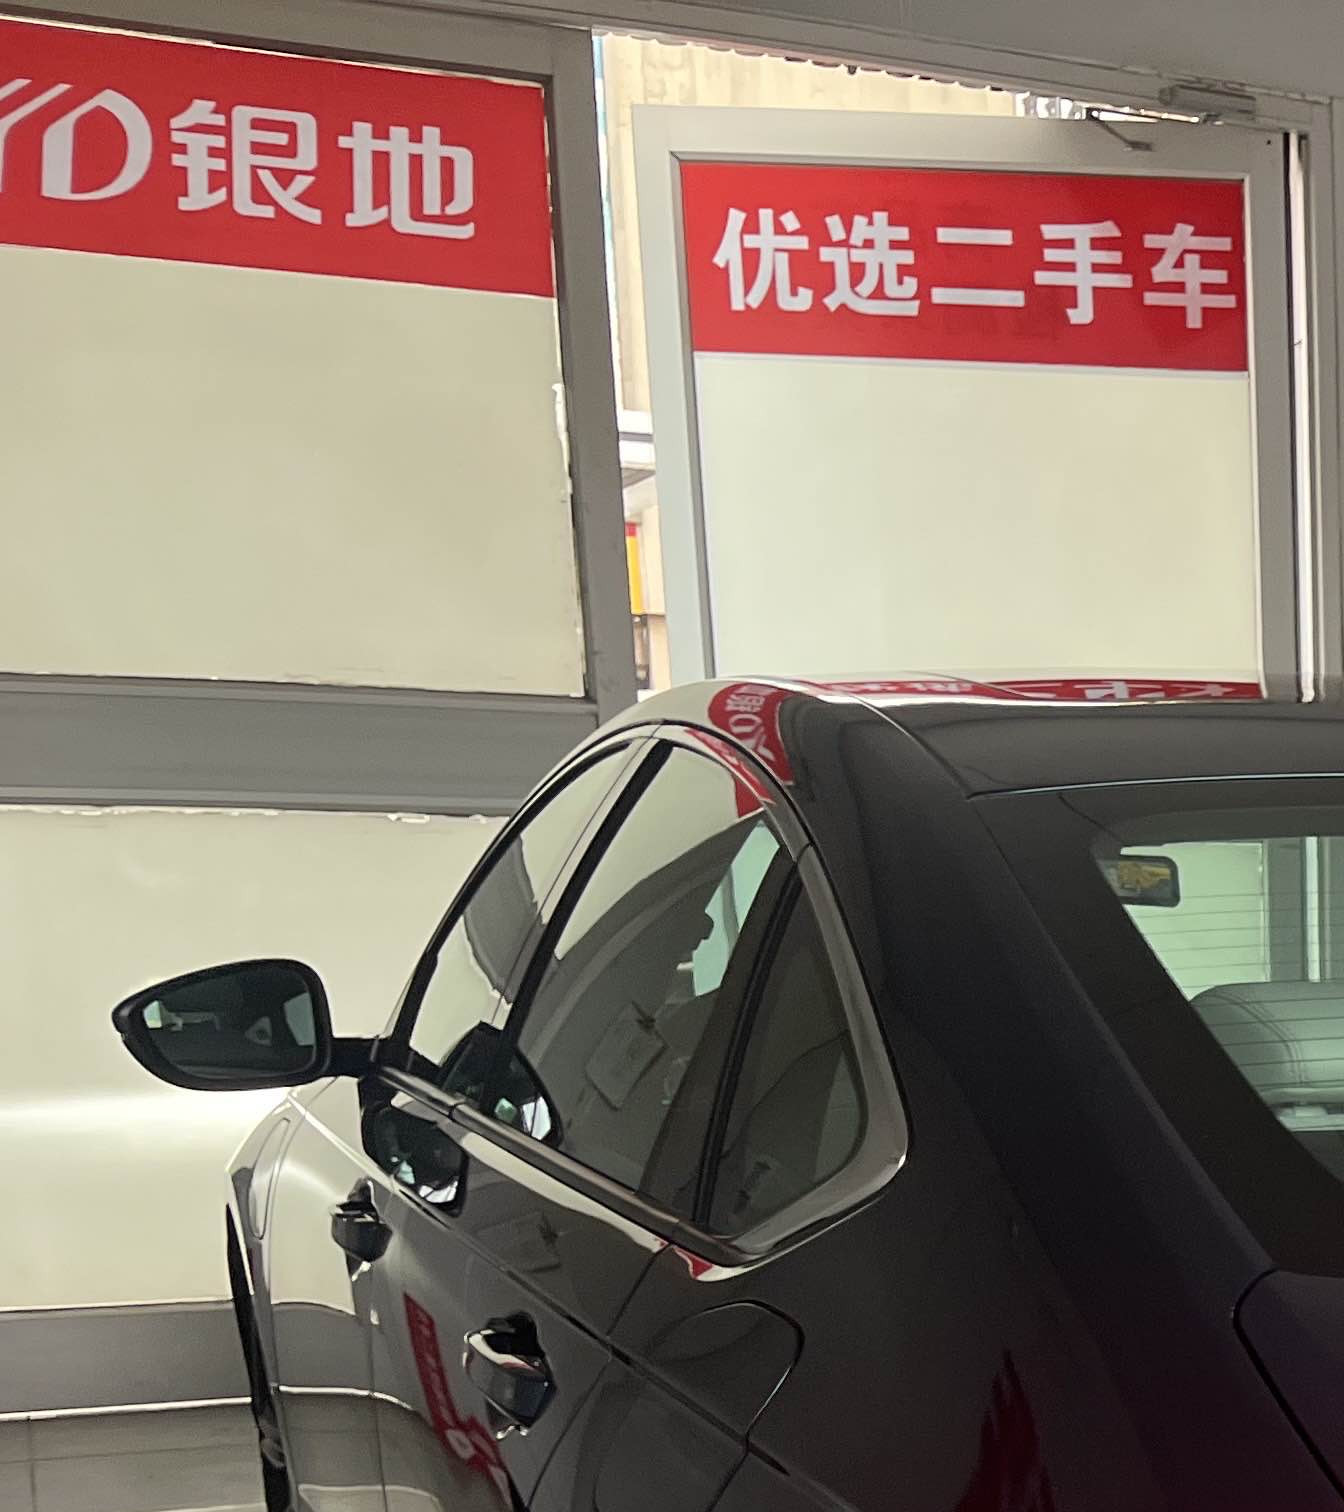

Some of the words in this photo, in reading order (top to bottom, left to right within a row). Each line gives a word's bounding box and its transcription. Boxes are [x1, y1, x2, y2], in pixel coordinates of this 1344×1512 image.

[169, 98, 476, 240] 银地
[712, 206, 1237, 329] 优选二手车
